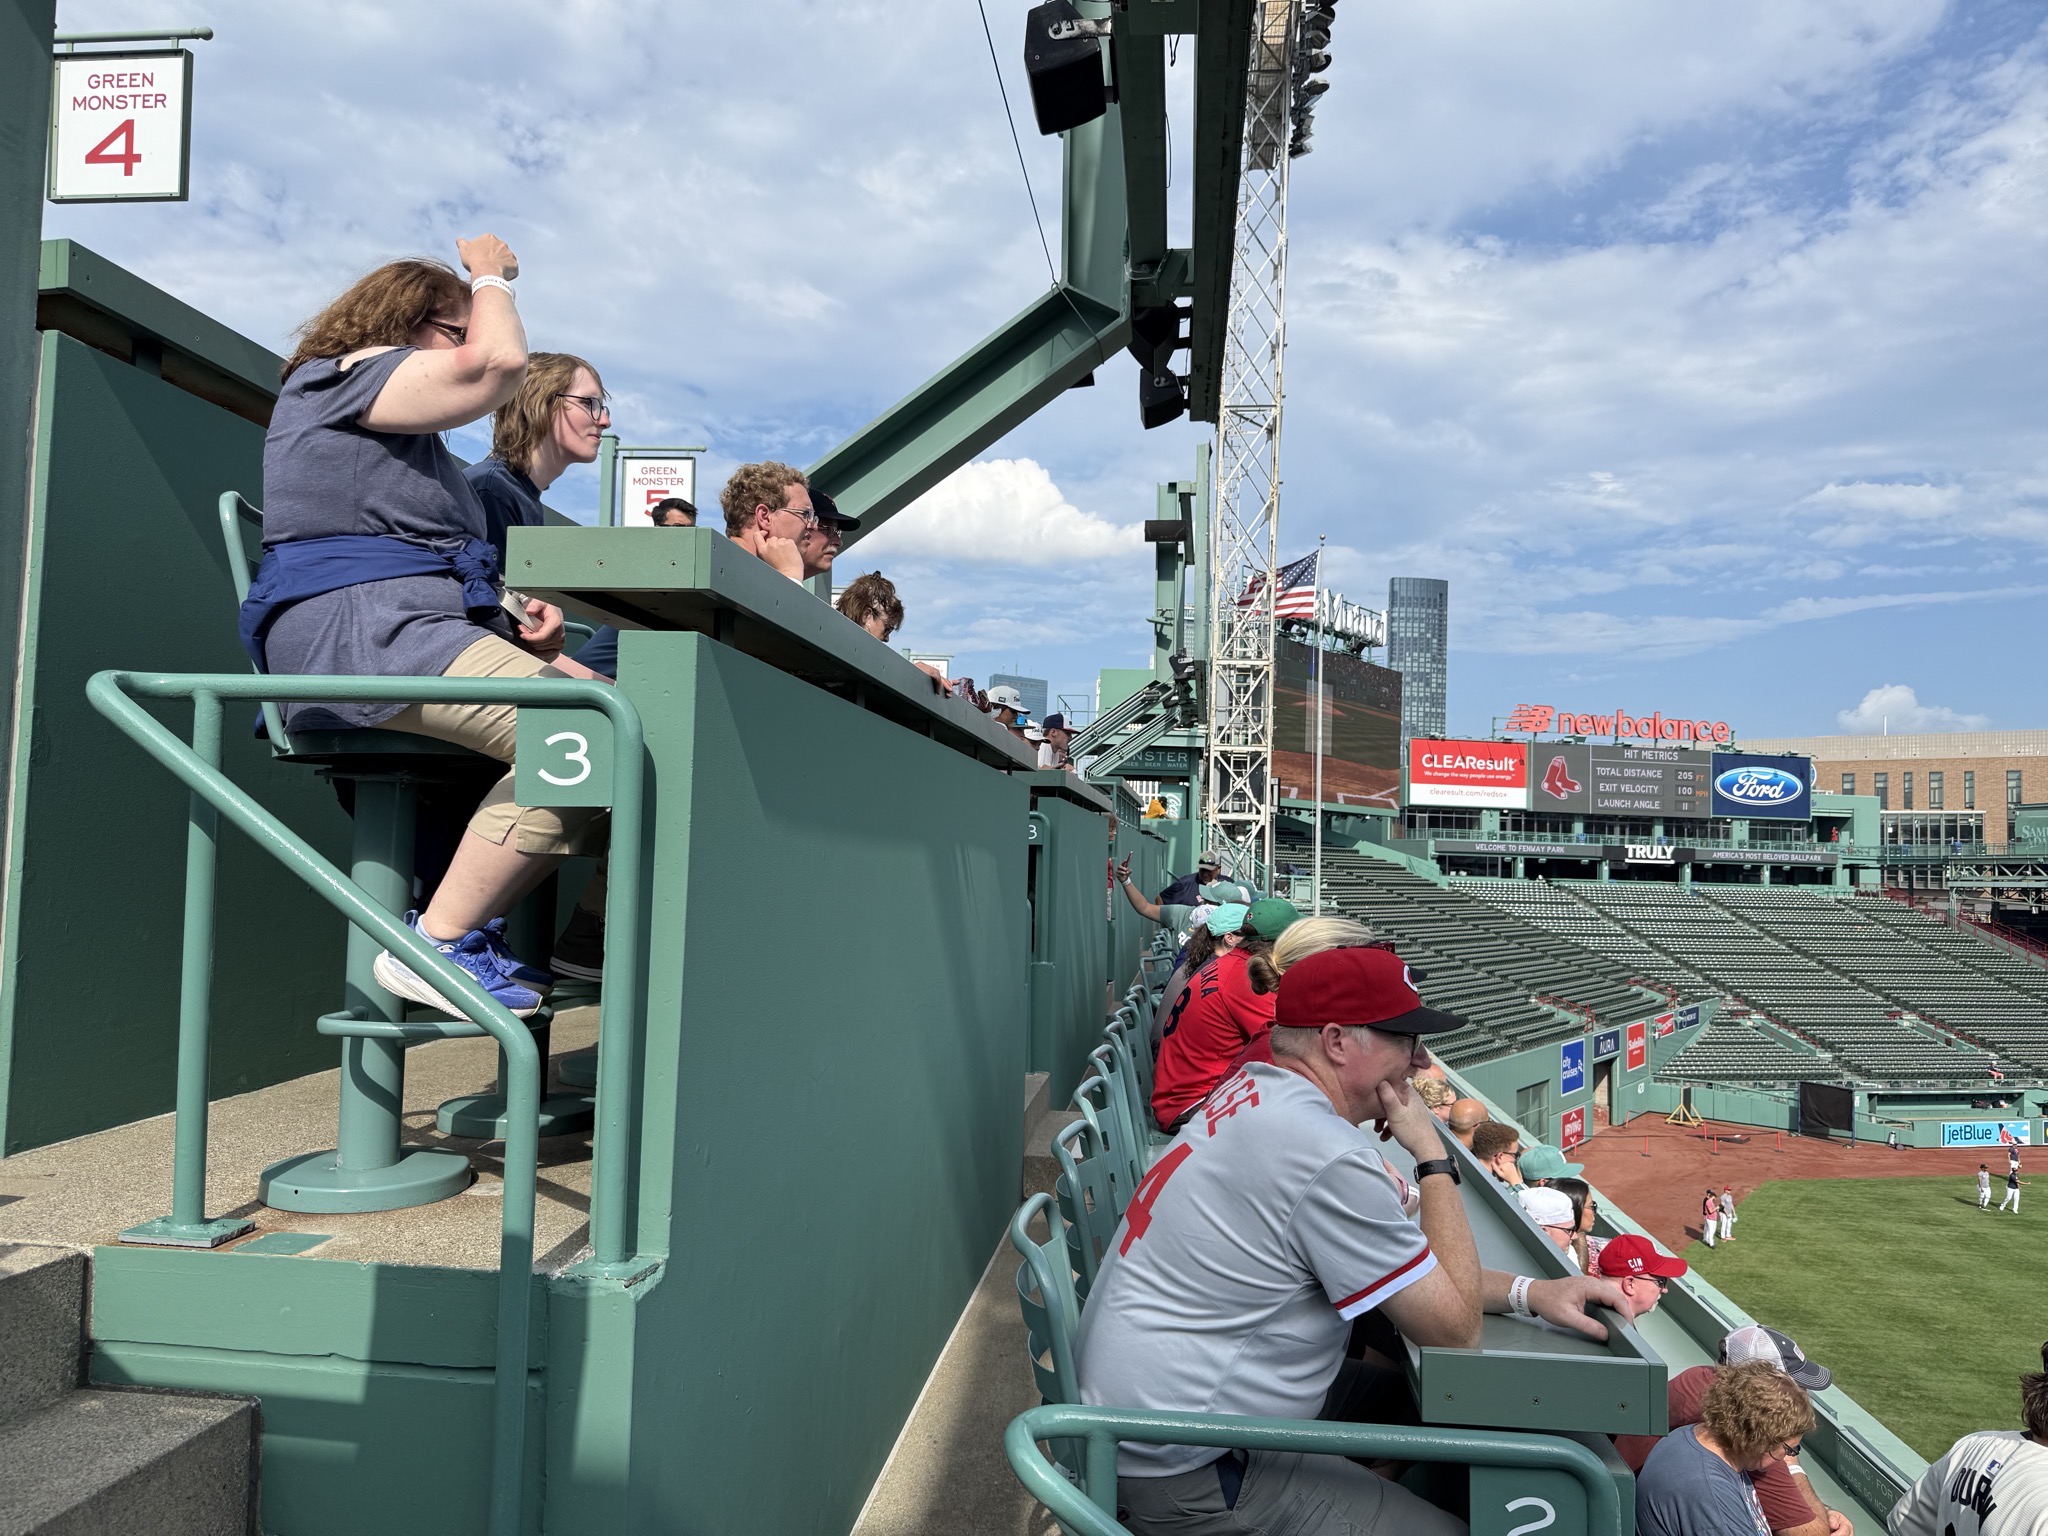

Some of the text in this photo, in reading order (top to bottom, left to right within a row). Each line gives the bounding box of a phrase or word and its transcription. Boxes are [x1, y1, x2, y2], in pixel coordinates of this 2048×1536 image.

[87, 72, 154, 89] GREEN
[72, 93, 167, 111] MONSTER
[85, 118, 142, 177] 4
[641, 466, 677, 475] GREEN
[633, 477, 684, 486] MONSTER
[537, 731, 592, 787] 3
[1133, 751, 1188, 762] NSTER
[1624, 749, 1678, 760] HIT METRICS
[1421, 753, 1516, 772] CLEAResult
[1596, 767, 1621, 776] TOTAL
[1623, 769, 1663, 778] DISTANCE
[1677, 771, 1693, 780] 205
[1429, 787, 1508, 798] clearesult.com/redsox
[1600, 783, 1709, 798] EXIT VELOCITY 100 MPH
[1732, 772, 1785, 798] Ford
[1598, 799, 1631, 808] LAUNCH
[1633, 801, 1660, 809] ANGLE
[1028, 824, 1038, 840] 3
[1475, 843, 1506, 852] WELCOME
[1518, 845, 1545, 853] FENWAY
[1625, 845, 1675, 860] TRULY
[1712, 852, 1822, 862] AMERICA'S MOST BELOVED BALLPARK
[1162, 986, 1192, 1039] 8
[1562, 1056, 1572, 1069] city
[1562, 1066, 1579, 1079] cruises
[1201, 1070, 1260, 1138] OSE
[1564, 1118, 1582, 1137] IRVING
[1947, 1124, 1992, 1144] jetBlue
[1119, 1141, 1194, 1258] 4
[1627, 1257, 1643, 1269] CIN
[1863, 1487, 1874, 1501] DO
[1875, 1478, 1895, 1503] FOR
[1505, 1497, 1556, 1536] 2
